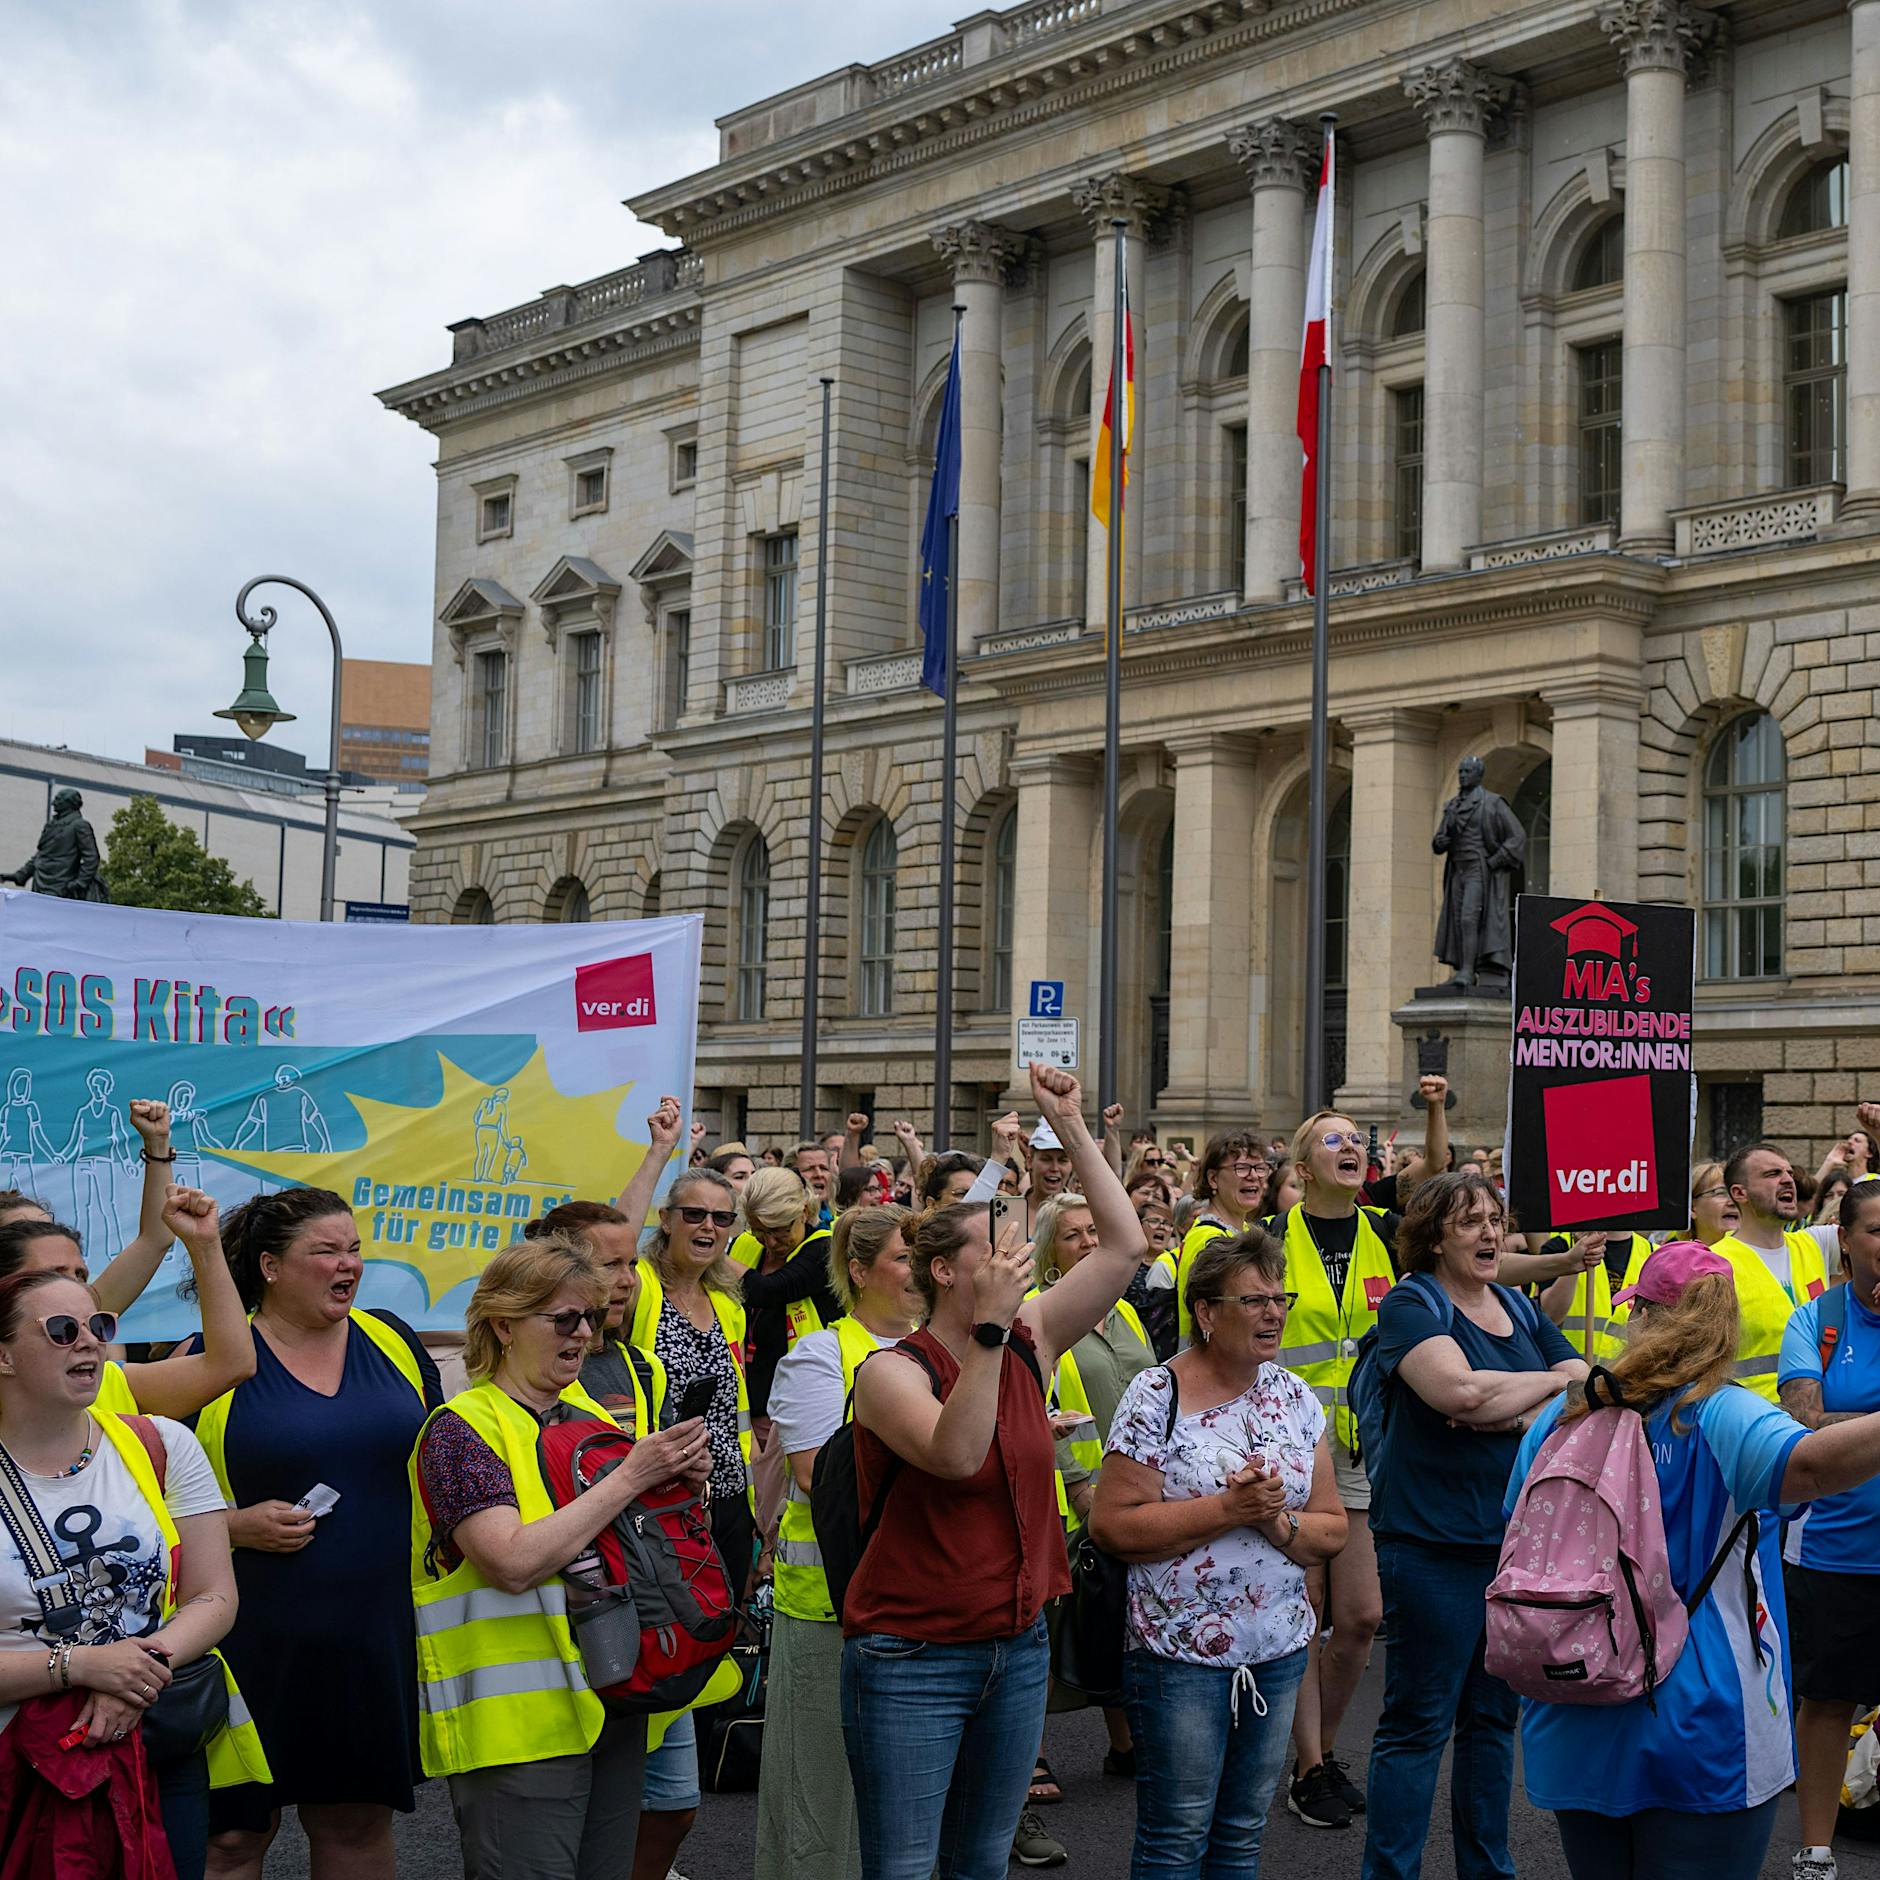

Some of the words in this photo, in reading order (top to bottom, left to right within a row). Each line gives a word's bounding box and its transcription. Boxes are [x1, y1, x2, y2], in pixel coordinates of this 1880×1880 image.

[1562, 959, 1652, 1004] MIA's
[581, 997, 650, 1017] ver.di
[1036, 985, 1056, 1013] P
[1516, 1006, 1690, 1039] AUSZUBILDENDE
[1516, 1038, 1690, 1070] MENTOR:INNEN
[1556, 1160, 1648, 1194] ver.di
[352, 1176, 532, 1218] Gemeinsam
[372, 1210, 421, 1244] für
[426, 1219, 500, 1250] gute
[1652, 1442, 1672, 1465] ON
